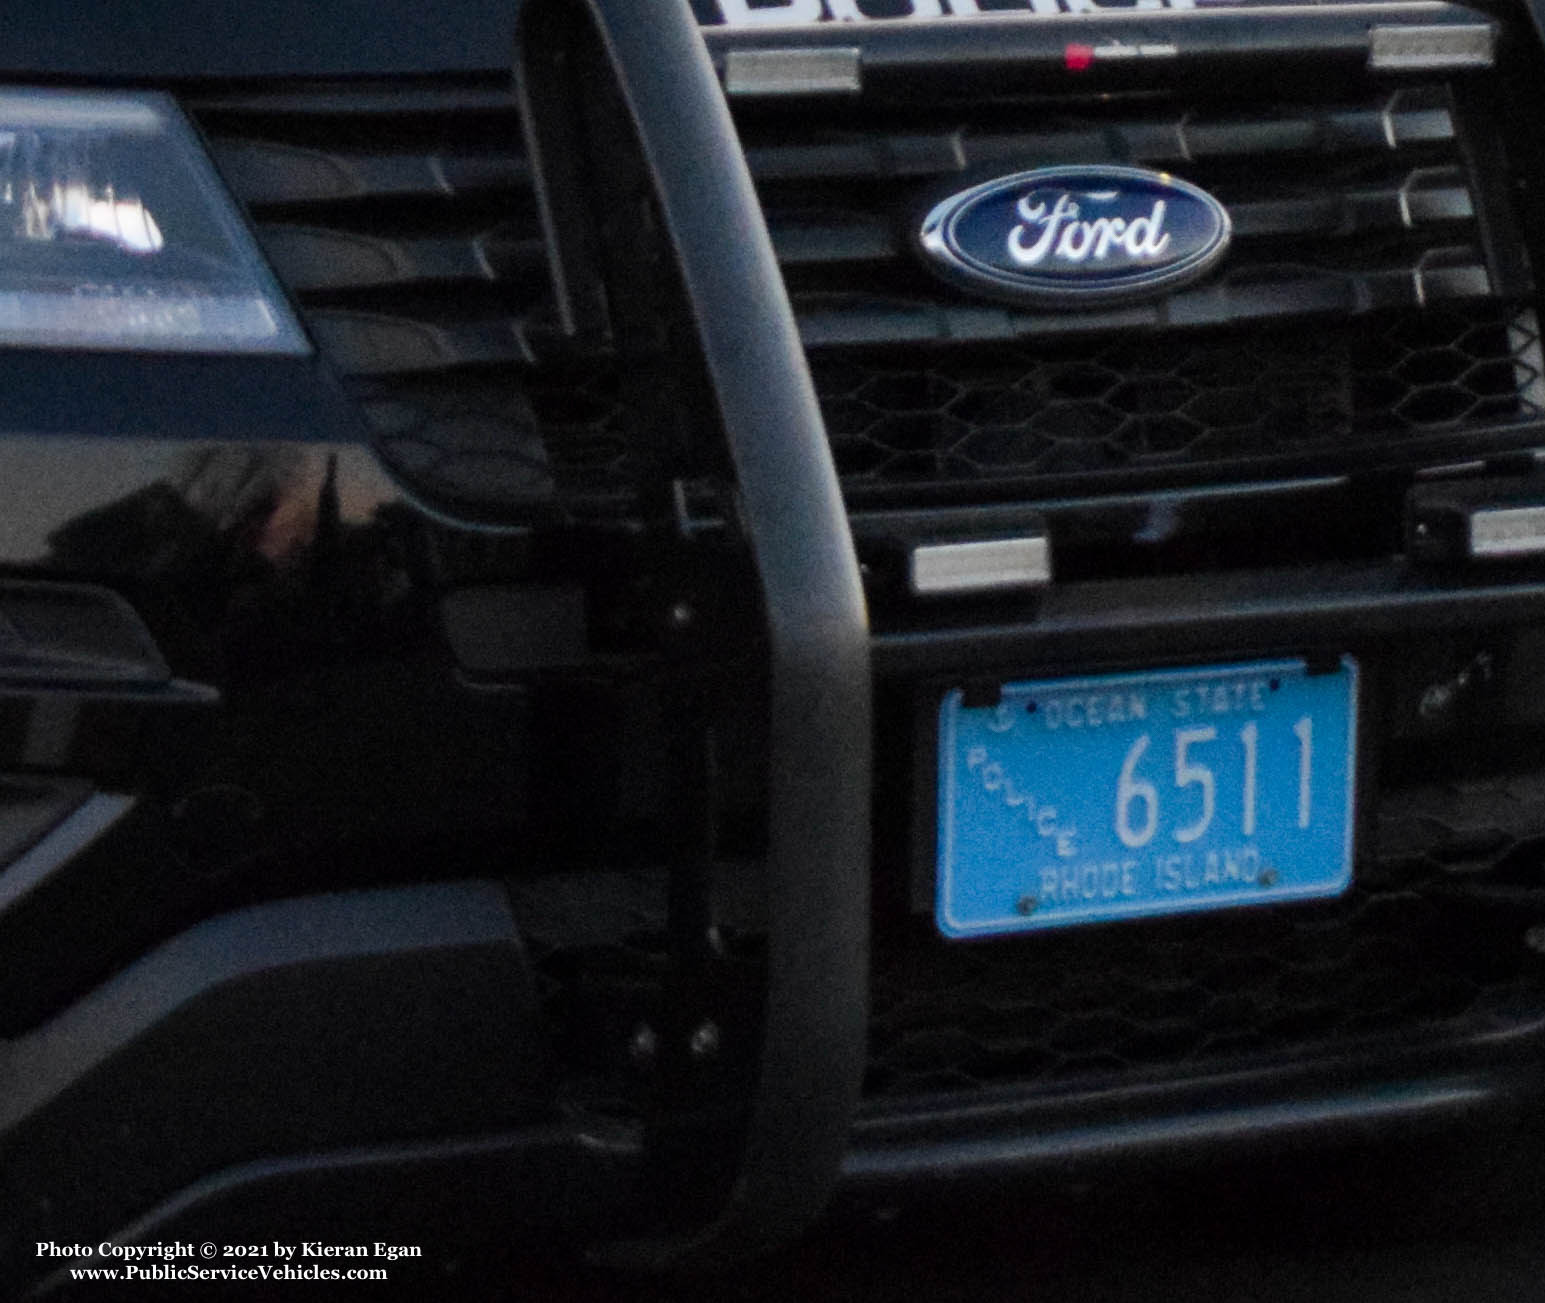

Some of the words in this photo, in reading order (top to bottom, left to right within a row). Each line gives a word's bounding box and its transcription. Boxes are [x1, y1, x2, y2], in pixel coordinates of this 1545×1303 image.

[1007, 192, 1170, 265] Ford
[1045, 693, 1147, 730] OCEAN
[1169, 679, 1266, 718] STATE
[966, 746, 1077, 857] POLICE
[1115, 716, 1312, 848] 6511
[1039, 860, 1139, 900] RHODE
[1155, 846, 1260, 889] ISLAND
